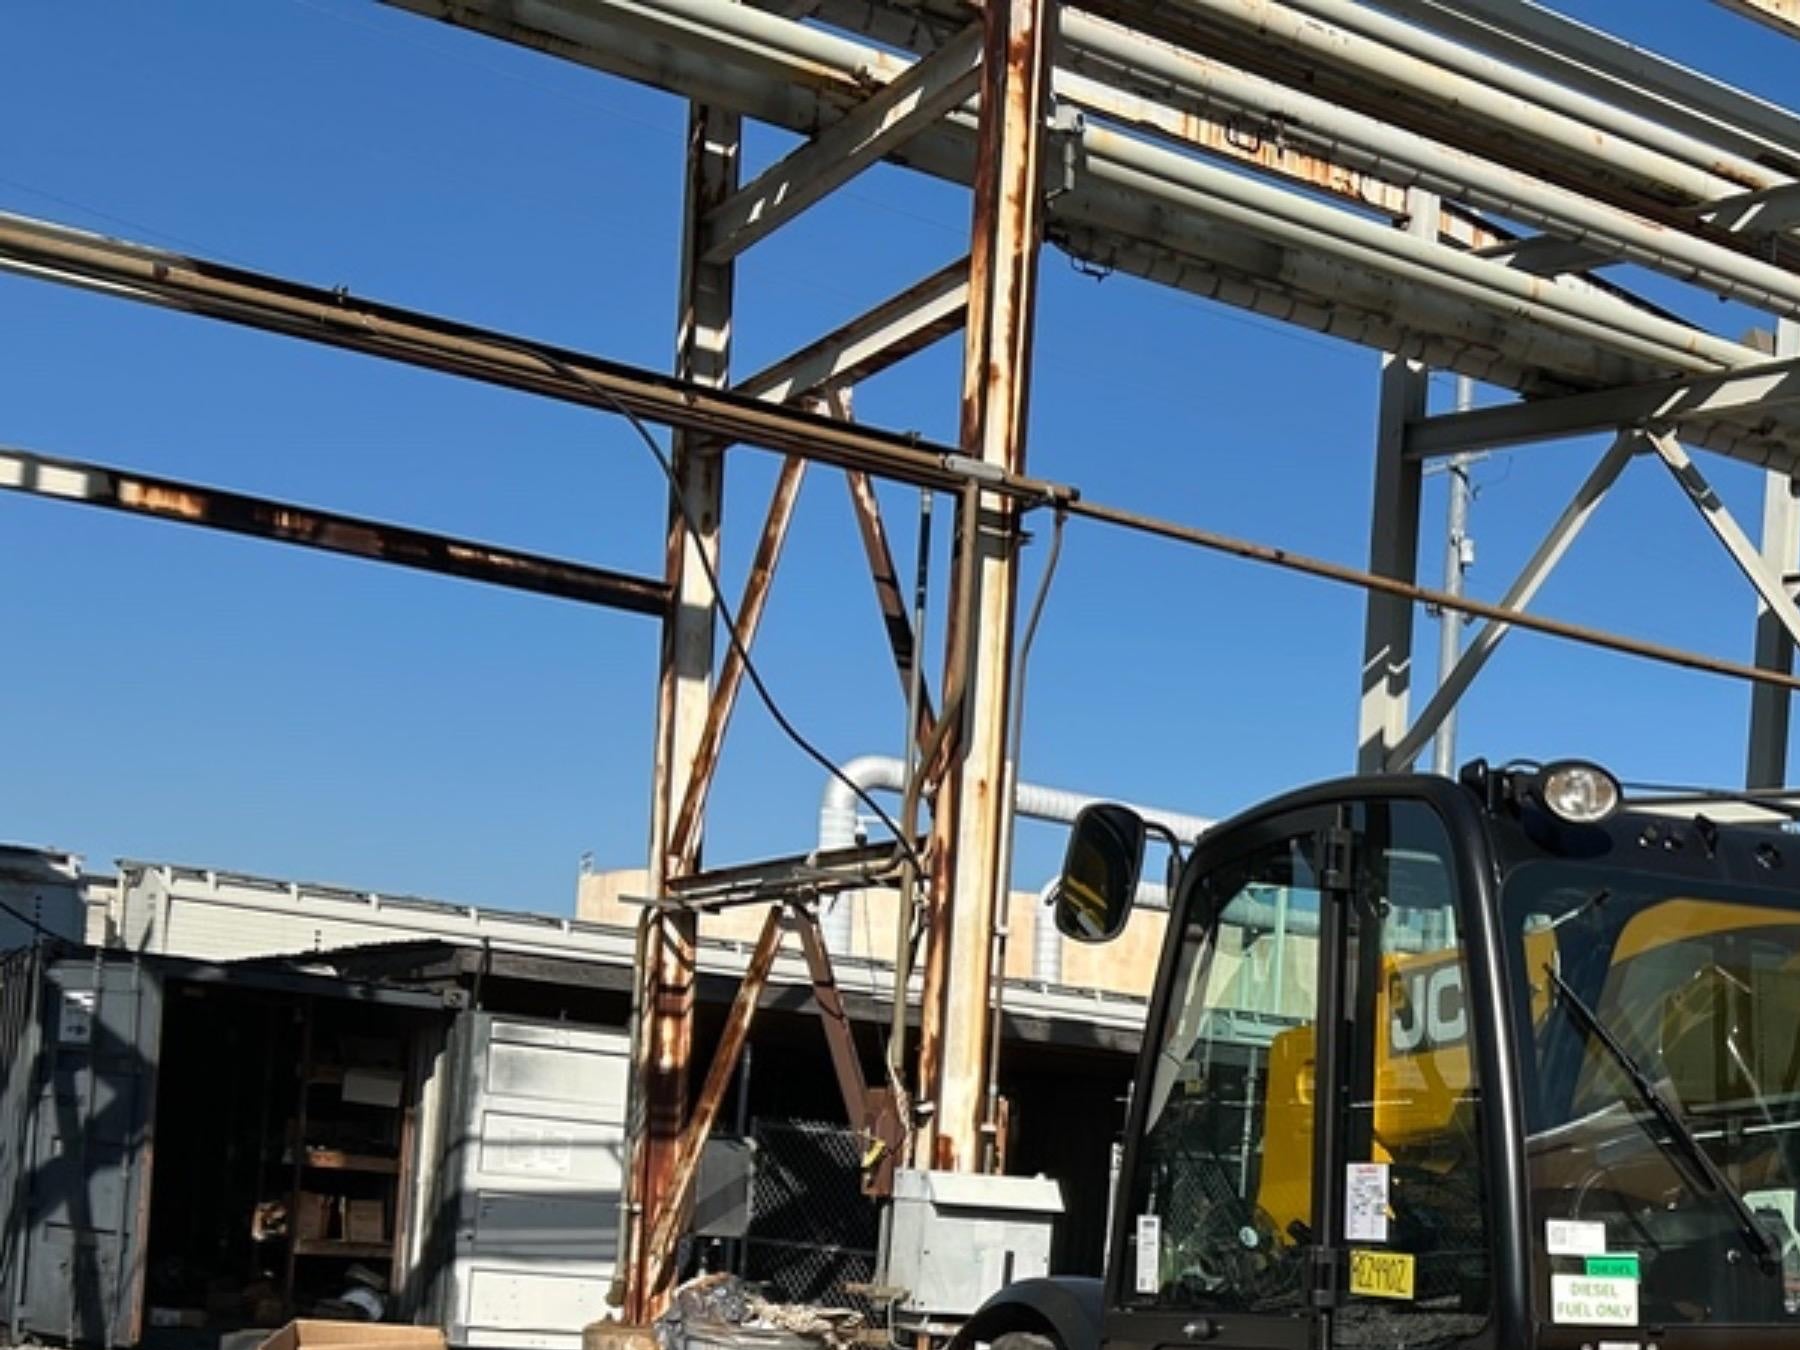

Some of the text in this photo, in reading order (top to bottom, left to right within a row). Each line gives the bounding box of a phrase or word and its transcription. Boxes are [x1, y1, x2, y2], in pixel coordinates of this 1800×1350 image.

[1570, 1283, 1619, 1298] DIESEL
[1558, 1302, 1632, 1319] FUEL ONLY
